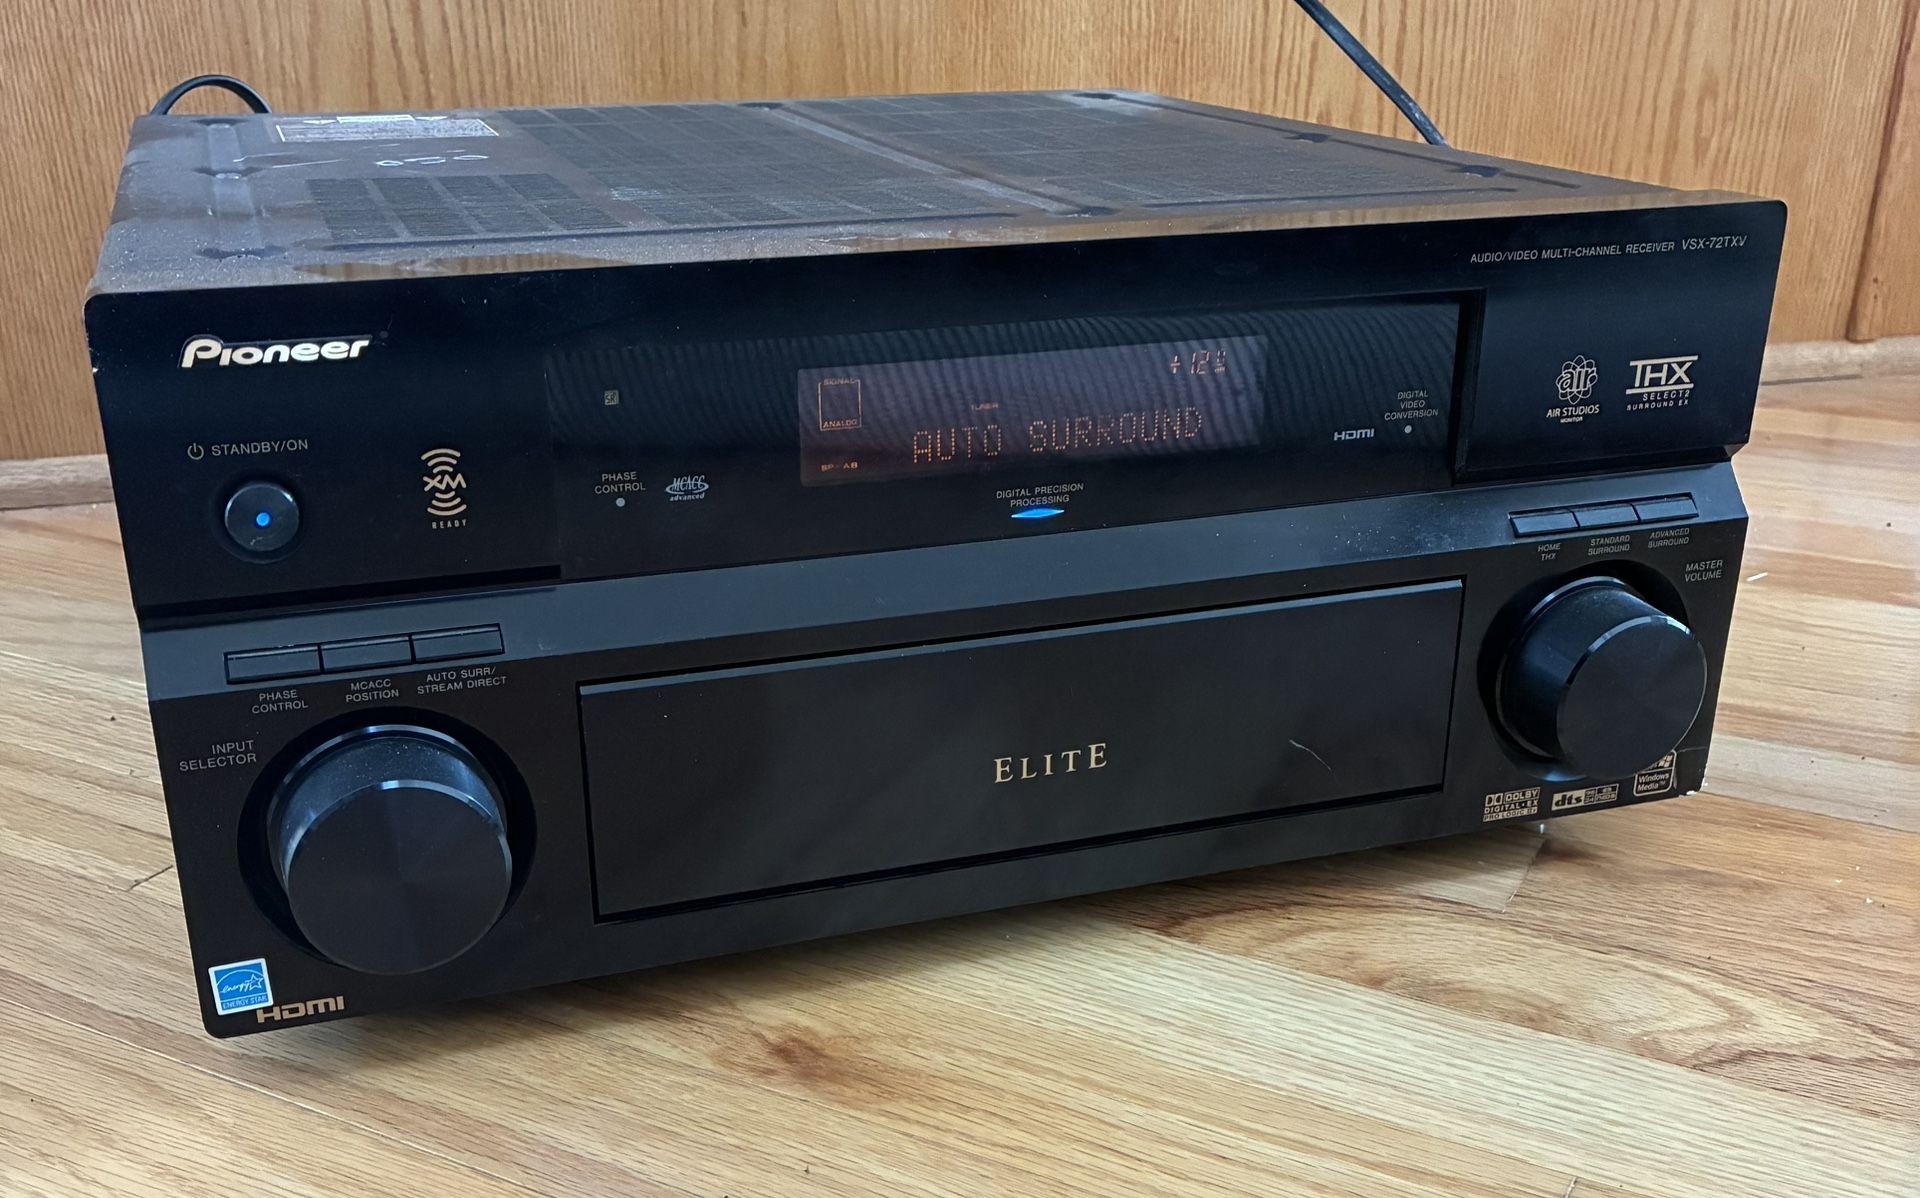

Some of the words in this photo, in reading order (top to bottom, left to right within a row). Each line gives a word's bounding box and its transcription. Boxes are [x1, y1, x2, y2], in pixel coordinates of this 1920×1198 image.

[1470, 250, 1539, 263] AUDIO/VIDEO
[1541, 244, 1622, 259] MULTI-CHANNEL
[1625, 241, 1676, 254] RECEIVER
[1681, 235, 1748, 250] VSX-72TXV
[180, 335, 372, 369] Pioneer
[1627, 355, 1698, 394] THX
[1397, 390, 1429, 400] DIGITAL
[1642, 389, 1691, 401] SELECT2
[1400, 400, 1426, 409] VIDEO
[1546, 408, 1561, 418] AIR
[1562, 404, 1600, 417] STUDIOS
[1626, 400, 1674, 411] SURROUND
[1384, 408, 1439, 421] CONVERSION
[822, 419, 858, 429] ANALOG
[912, 424, 1002, 464] AUTO
[1028, 406, 1203, 453] SURROUND
[1333, 428, 1375, 441] HDMI
[211, 438, 309, 457] STANDBY/ON
[422, 473, 467, 492] XM
[601, 471, 638, 482] PHASE
[594, 482, 647, 494] CONTROL
[996, 488, 1032, 499] DIGITAL
[1035, 483, 1085, 495] PRECISION
[1010, 494, 1070, 507] PROCESSING
[431, 518, 468, 530] READY
[1650, 528, 1690, 539] ADVANCED
[1537, 542, 1562, 552] HOME
[1590, 535, 1631, 546] STANDARD
[1648, 537, 1690, 549] SURROUND
[1541, 552, 1557, 561] THX
[1588, 544, 1631, 556] SURROUND
[1685, 559, 1724, 571] MASTER
[1684, 570, 1723, 582] VOLUME
[426, 671, 457, 682] AUTO
[461, 666, 496, 680] SURR/
[350, 678, 392, 690] MCACC
[416, 681, 462, 695] STREAM
[467, 676, 508, 689] DIRECT
[258, 689, 298, 702] PHASE
[345, 688, 400, 703] POSITION
[251, 699, 309, 714] CONTROL
[211, 740, 255, 755] INPUT
[178, 753, 258, 772] SELECTOR
[993, 742, 1108, 784] ELITE
[1638, 773, 1670, 783] Windows
[1505, 789, 1539, 802] DOLBY
[1554, 793, 1584, 808] dts
[222, 999, 250, 1010] ENERGY
[251, 996, 268, 1006] STAR
[256, 995, 346, 1024] HDMI
